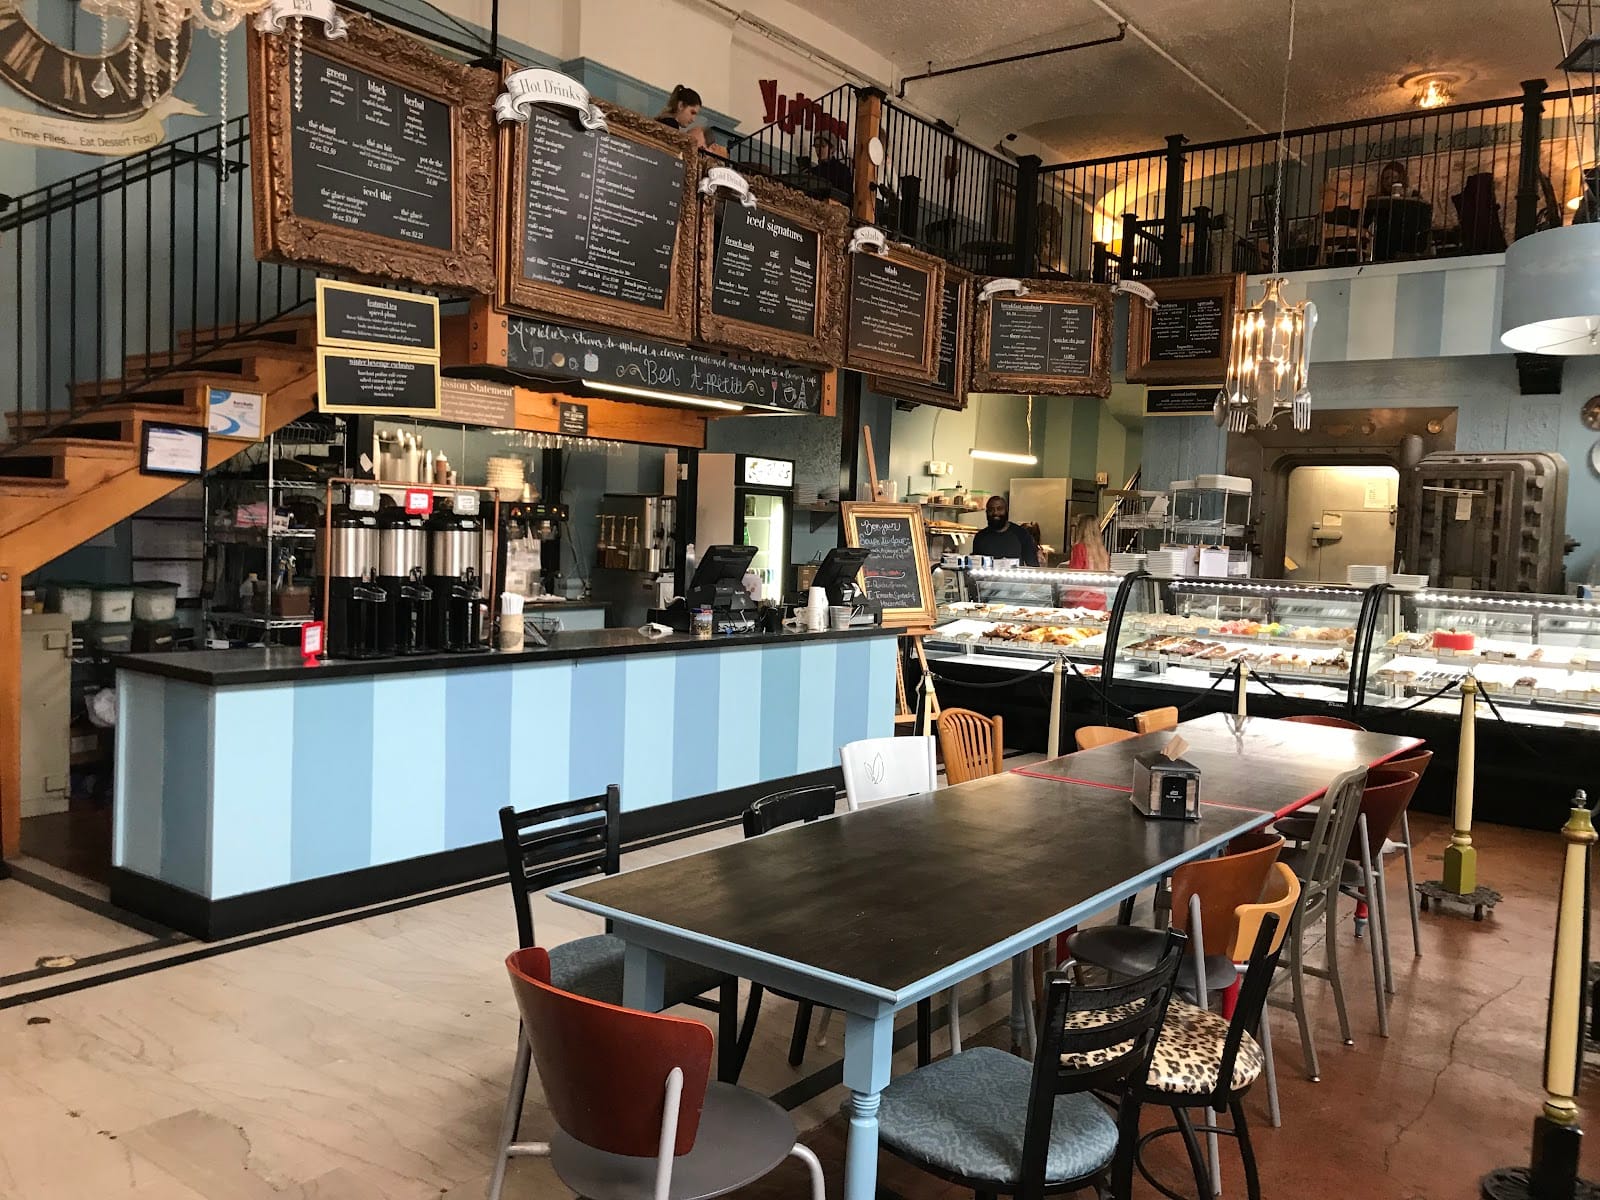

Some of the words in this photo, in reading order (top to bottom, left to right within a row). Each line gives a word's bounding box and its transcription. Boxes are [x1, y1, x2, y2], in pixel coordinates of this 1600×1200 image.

[326, 67, 348, 82] green
[367, 79, 387, 97] black
[519, 79, 541, 94] Hot
[544, 79, 581, 102] Drinks
[403, 93, 425, 111] herbal
[97, 136, 130, 147] Dessert
[362, 185, 379, 199] iced
[379, 190, 392, 203] thé
[746, 211, 766, 230] iced
[766, 218, 805, 243] signatures
[441, 380, 468, 392] ission
[469, 382, 515, 398] Statement
